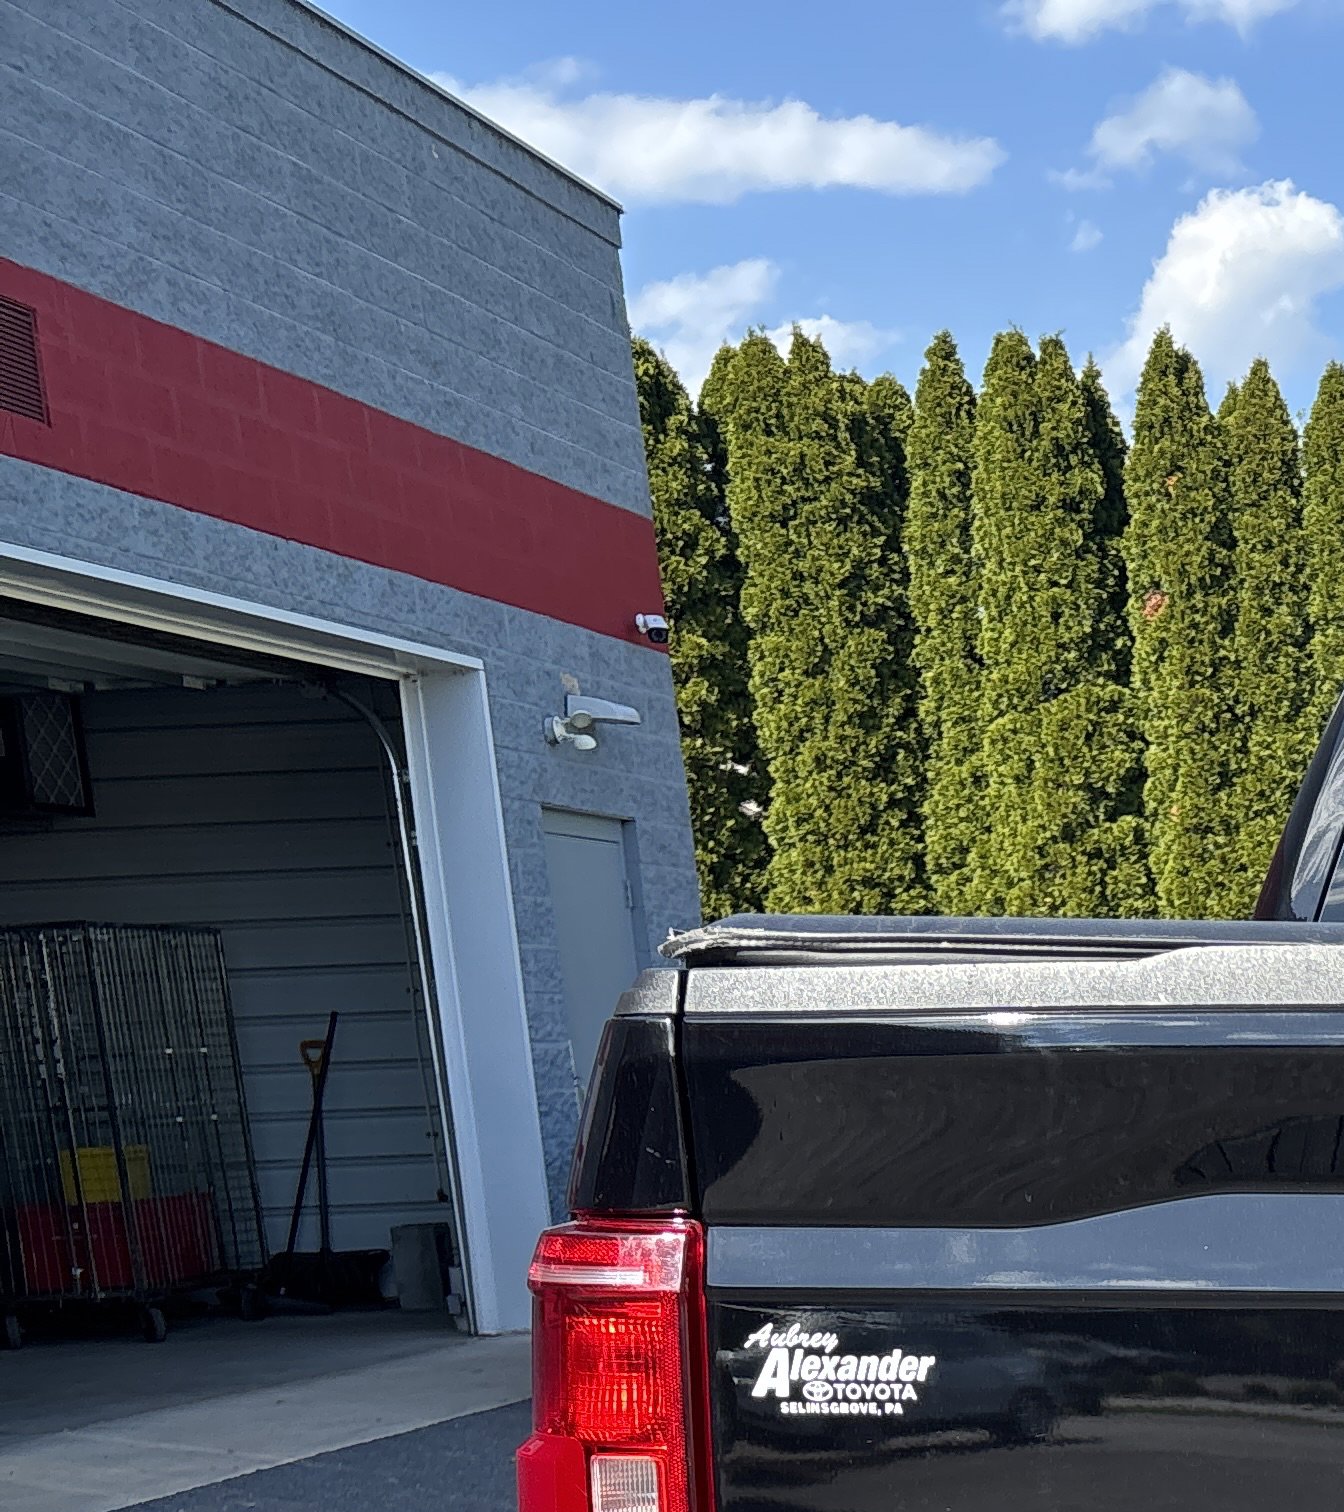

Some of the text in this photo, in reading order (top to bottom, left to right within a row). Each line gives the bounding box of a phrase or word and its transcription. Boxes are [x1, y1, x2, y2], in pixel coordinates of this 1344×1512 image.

[743, 1322, 839, 1354] Aubrey
[751, 1347, 936, 1398] Alexander
[833, 1382, 918, 1401] TOYOTA
[885, 1401, 904, 1415] PA
